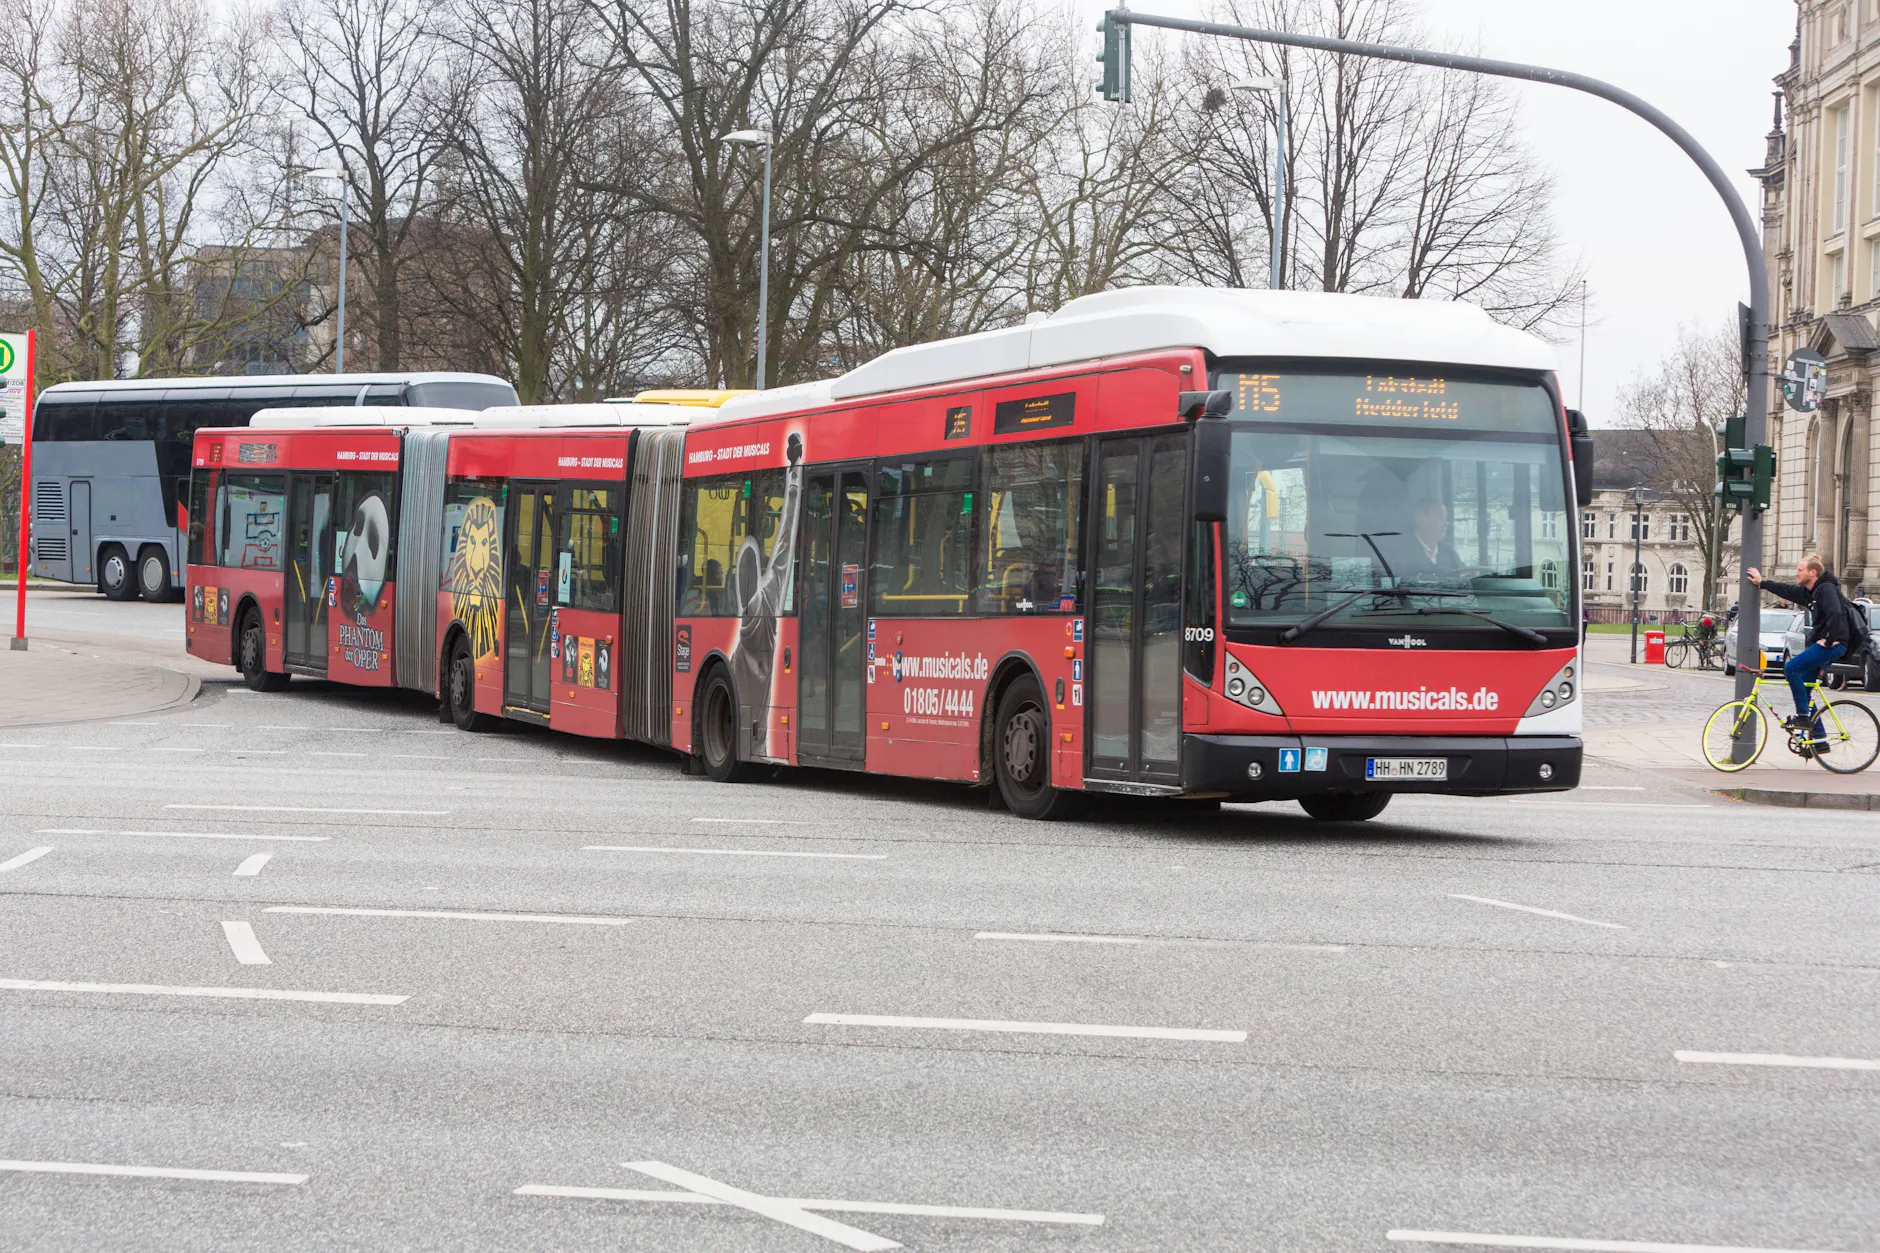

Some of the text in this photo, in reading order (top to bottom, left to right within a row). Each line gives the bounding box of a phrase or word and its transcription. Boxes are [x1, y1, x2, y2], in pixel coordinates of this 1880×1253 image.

[558, 456, 578, 467] HAMBURG
[581, 457, 593, 468] STADT
[593, 457, 602, 468] DER
[602, 458, 623, 469] MUSICALS
[688, 449, 713, 464] HAMBURG
[717, 447, 732, 461] STADT
[733, 445, 743, 459] DER
[744, 442, 770, 457] MUSICALS
[356, 612, 367, 626] Das
[338, 624, 384, 652] PHANTOM
[1184, 627, 1214, 642] 8709
[345, 648, 379, 670] der OPER
[677, 643, 690, 659] Stage
[891, 651, 989, 680] www.musicals.de
[1311, 686, 1499, 711] www.musicals.de
[1375, 761, 1446, 776] HH HN 2789
